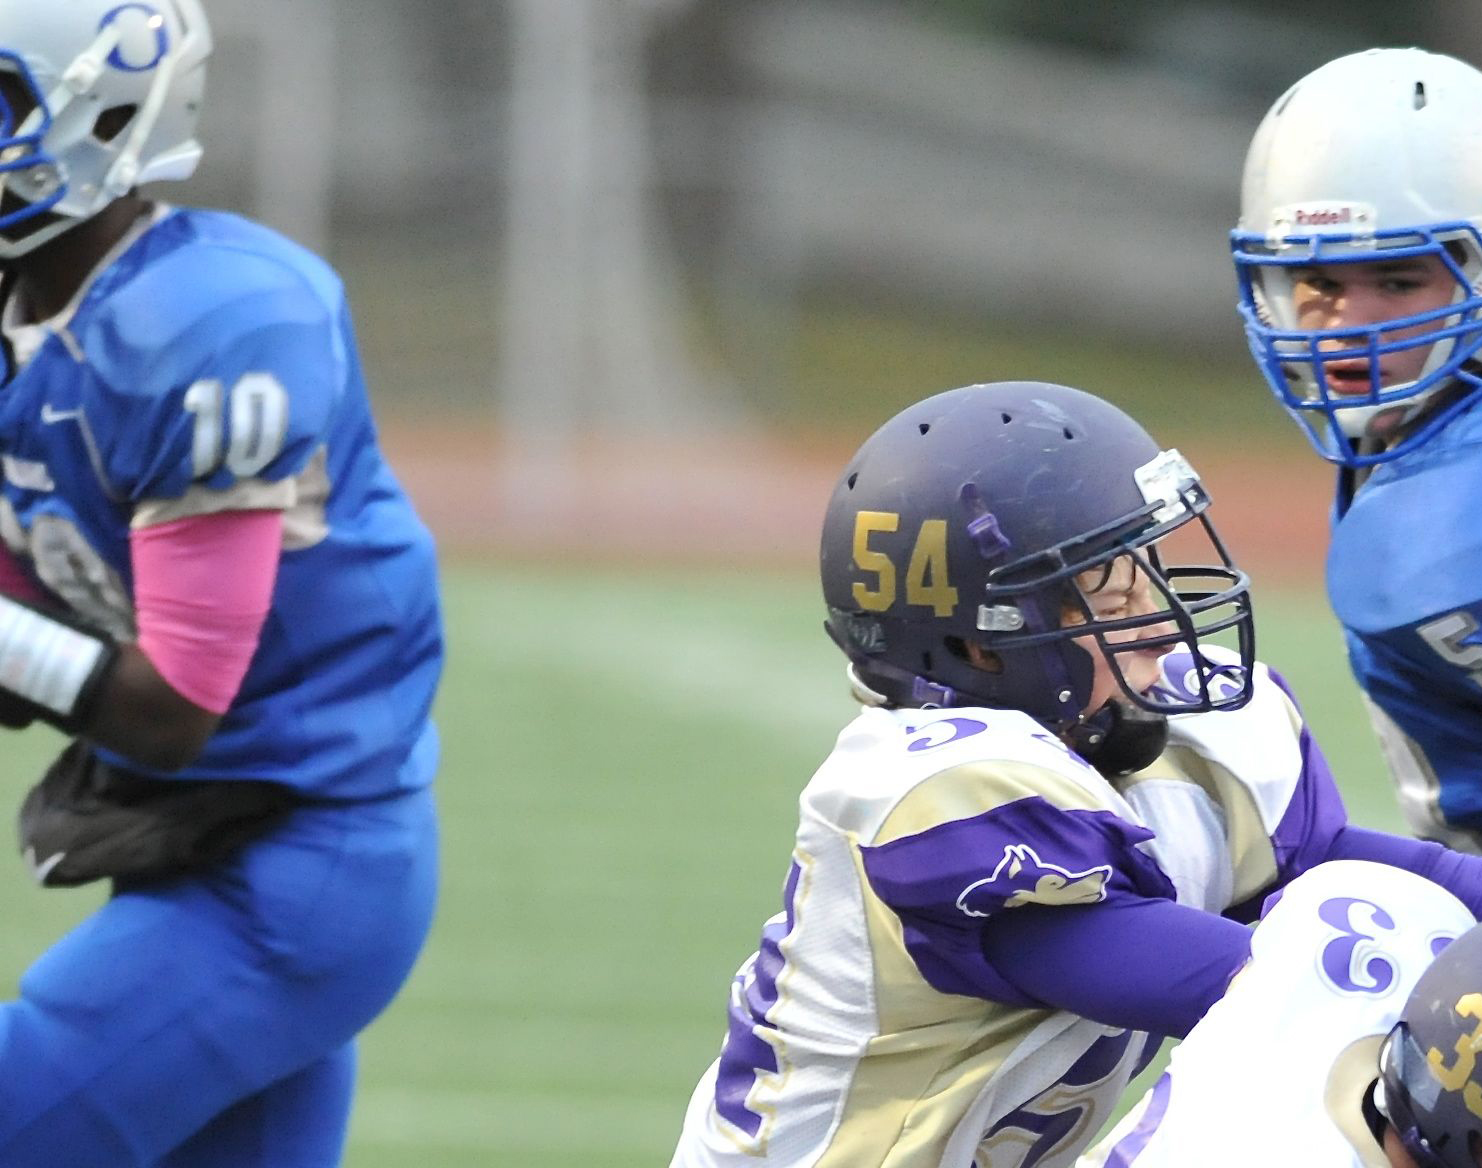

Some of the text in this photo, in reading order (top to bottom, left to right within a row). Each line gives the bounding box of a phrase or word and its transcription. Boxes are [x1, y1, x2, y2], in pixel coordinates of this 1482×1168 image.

[1296, 208, 1350, 225] Riddell
[184, 372, 287, 480] 10
[852, 511, 958, 617] 54
